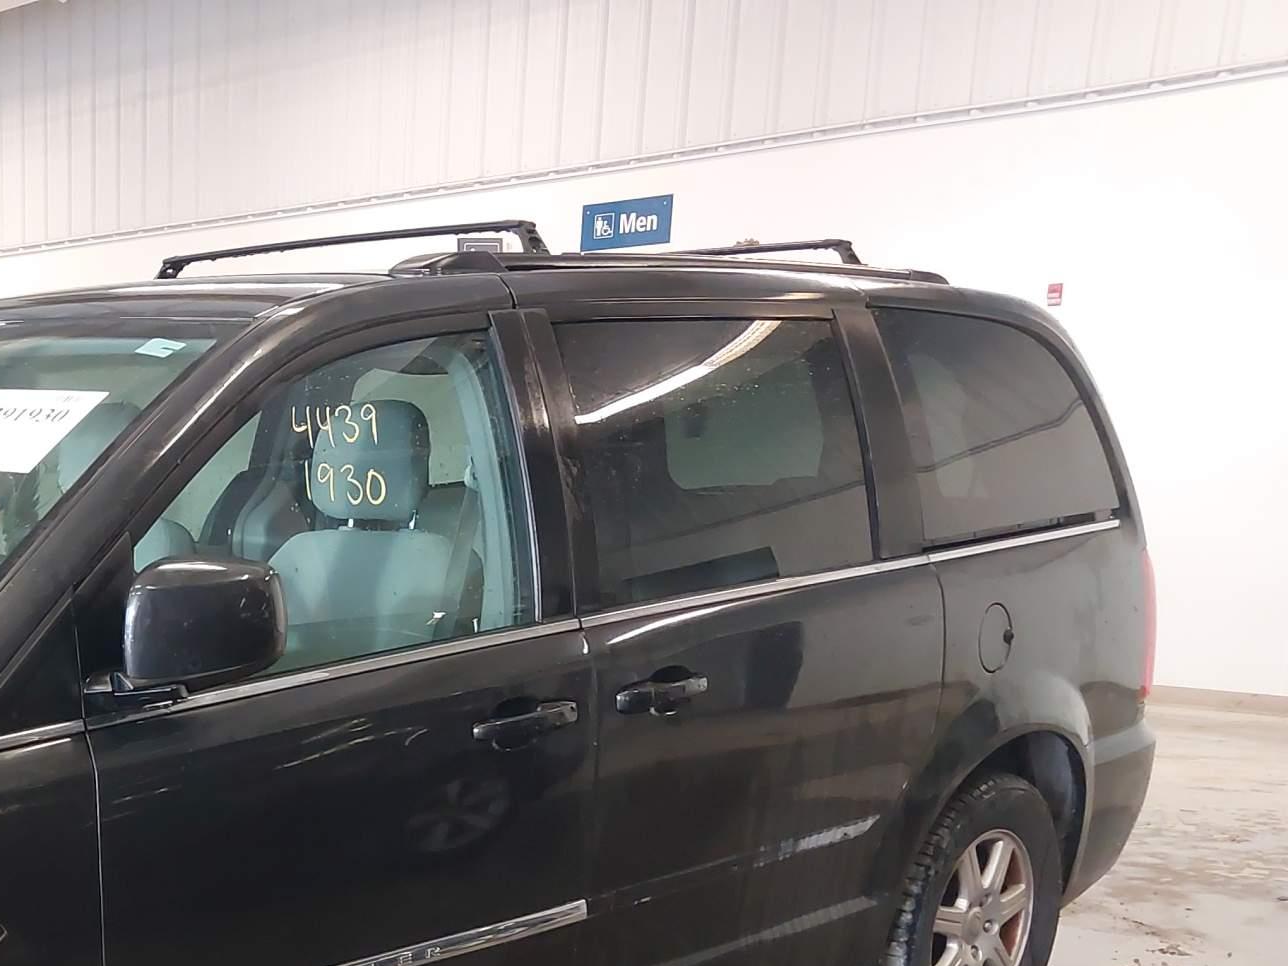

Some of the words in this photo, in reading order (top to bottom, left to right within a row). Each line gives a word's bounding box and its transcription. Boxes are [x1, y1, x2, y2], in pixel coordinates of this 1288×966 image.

[619, 212, 658, 234] Men
[292, 404, 378, 449] 4439
[305, 459, 386, 505] 1930
